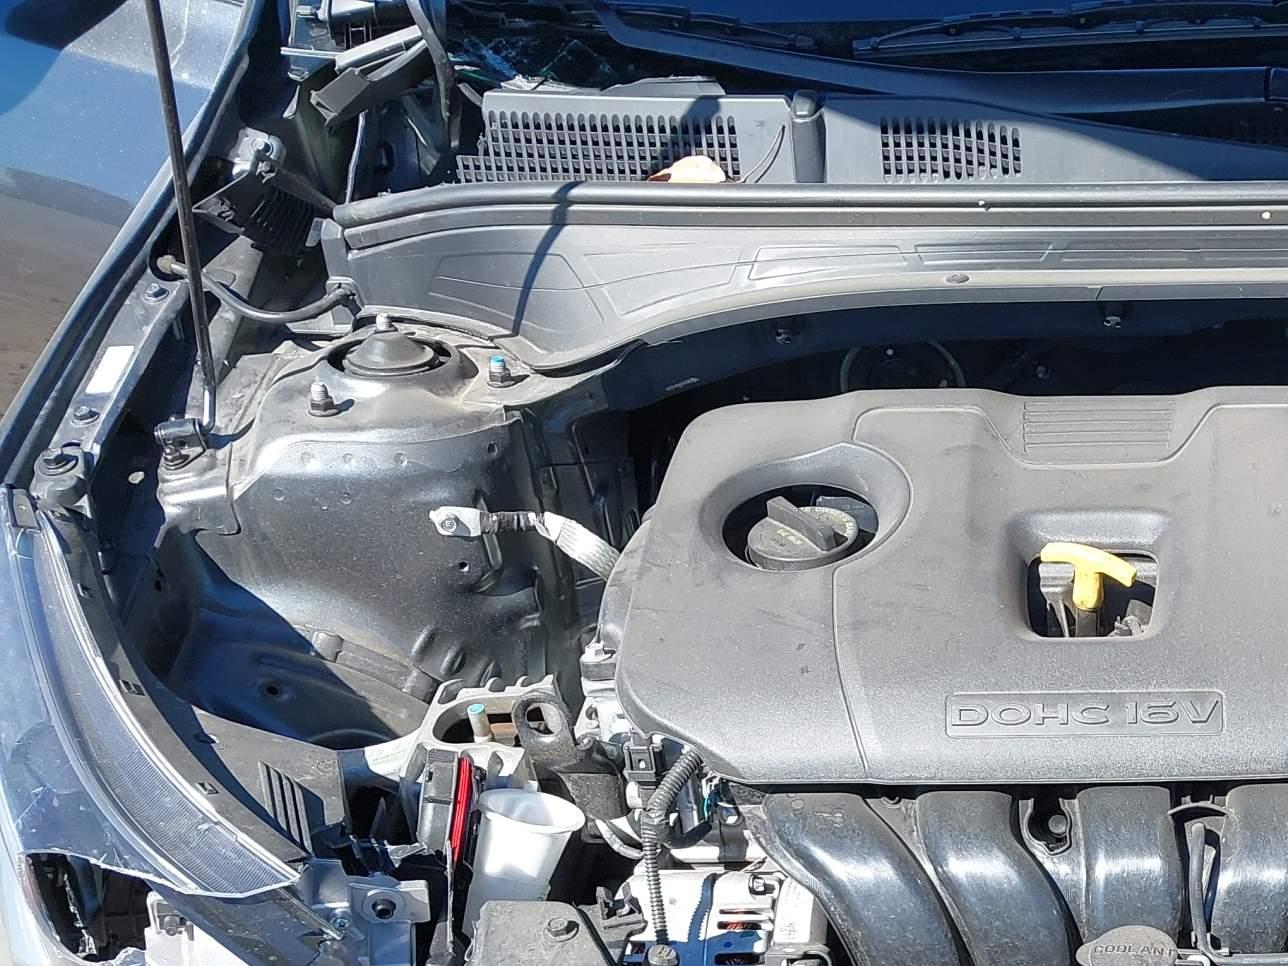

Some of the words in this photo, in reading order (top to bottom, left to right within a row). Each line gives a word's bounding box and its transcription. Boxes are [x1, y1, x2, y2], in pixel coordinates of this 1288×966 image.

[950, 702, 1111, 727] DOHC
[1124, 699, 1220, 726] 16V
[1093, 944, 1179, 958] COOLANT
